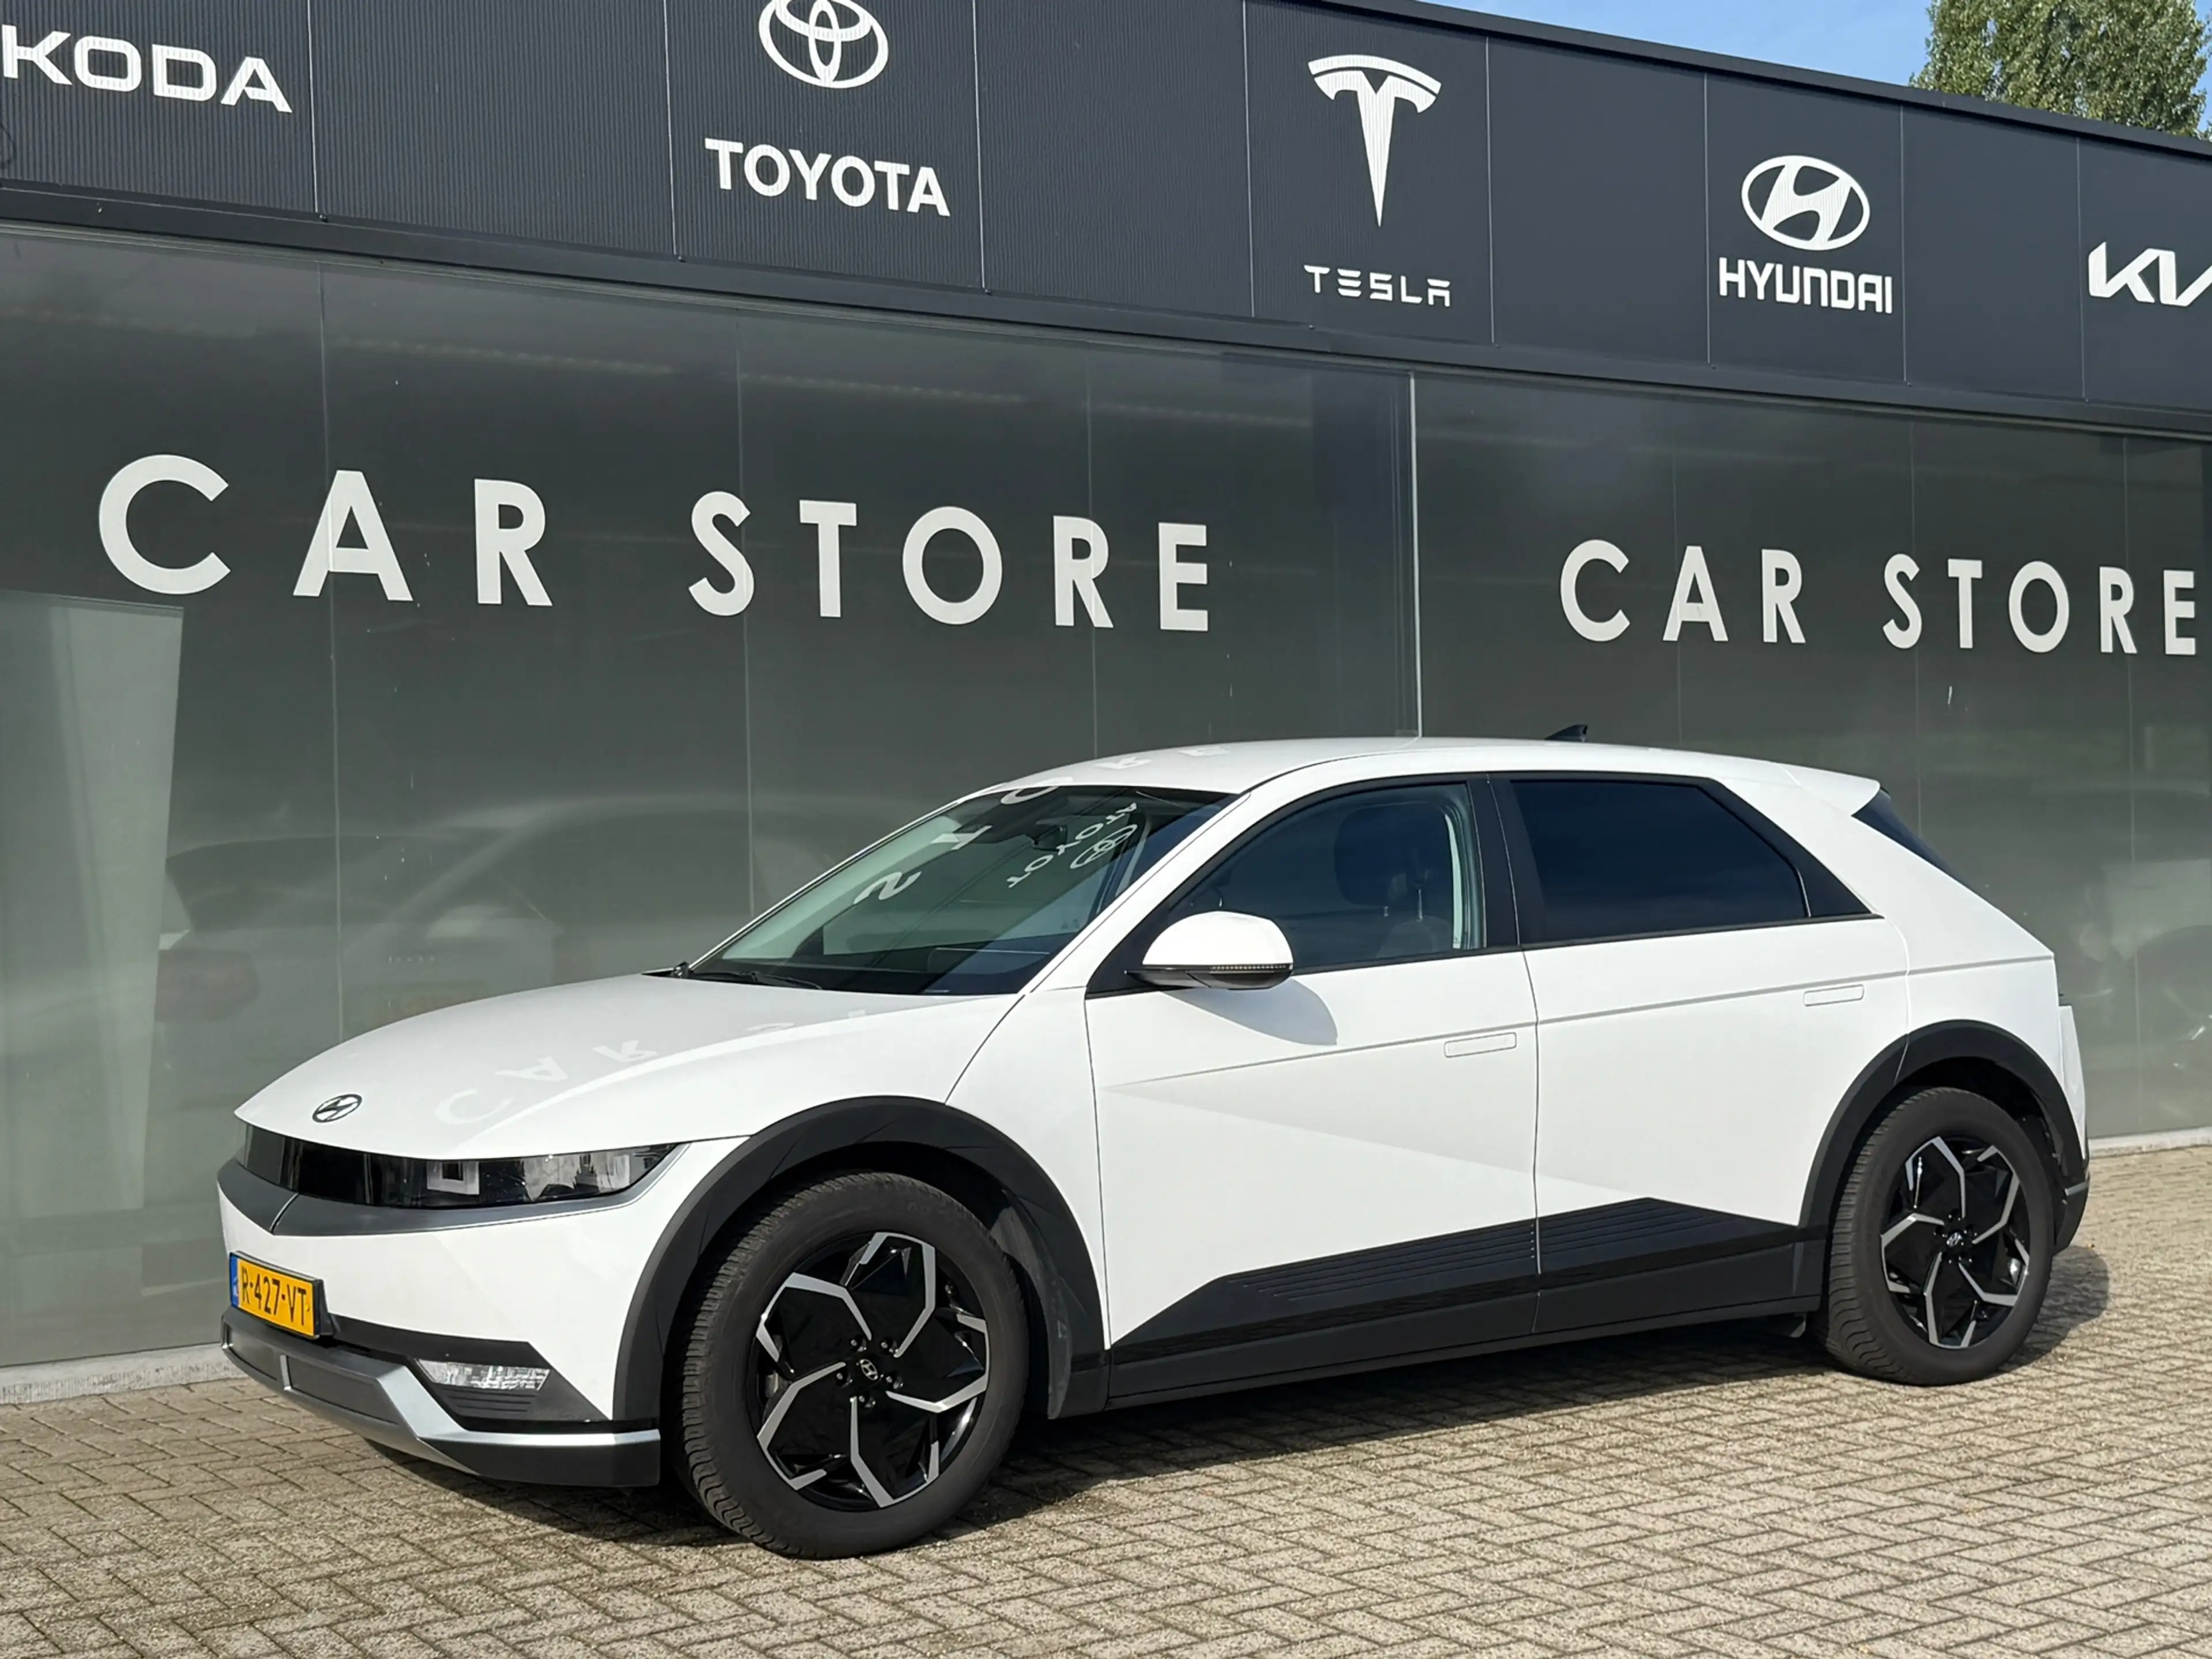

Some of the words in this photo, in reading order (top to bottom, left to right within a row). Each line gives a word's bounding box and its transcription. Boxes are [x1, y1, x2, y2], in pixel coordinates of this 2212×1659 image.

[704, 138, 950, 217] TOYOTA
[1304, 264, 1451, 307] TESLA
[1719, 257, 1893, 314] HYUNDAI
[99, 454, 553, 606] CAR
[689, 491, 1209, 631] STORE
[1560, 539, 1806, 643] CAR
[1883, 554, 2196, 656] STORE
